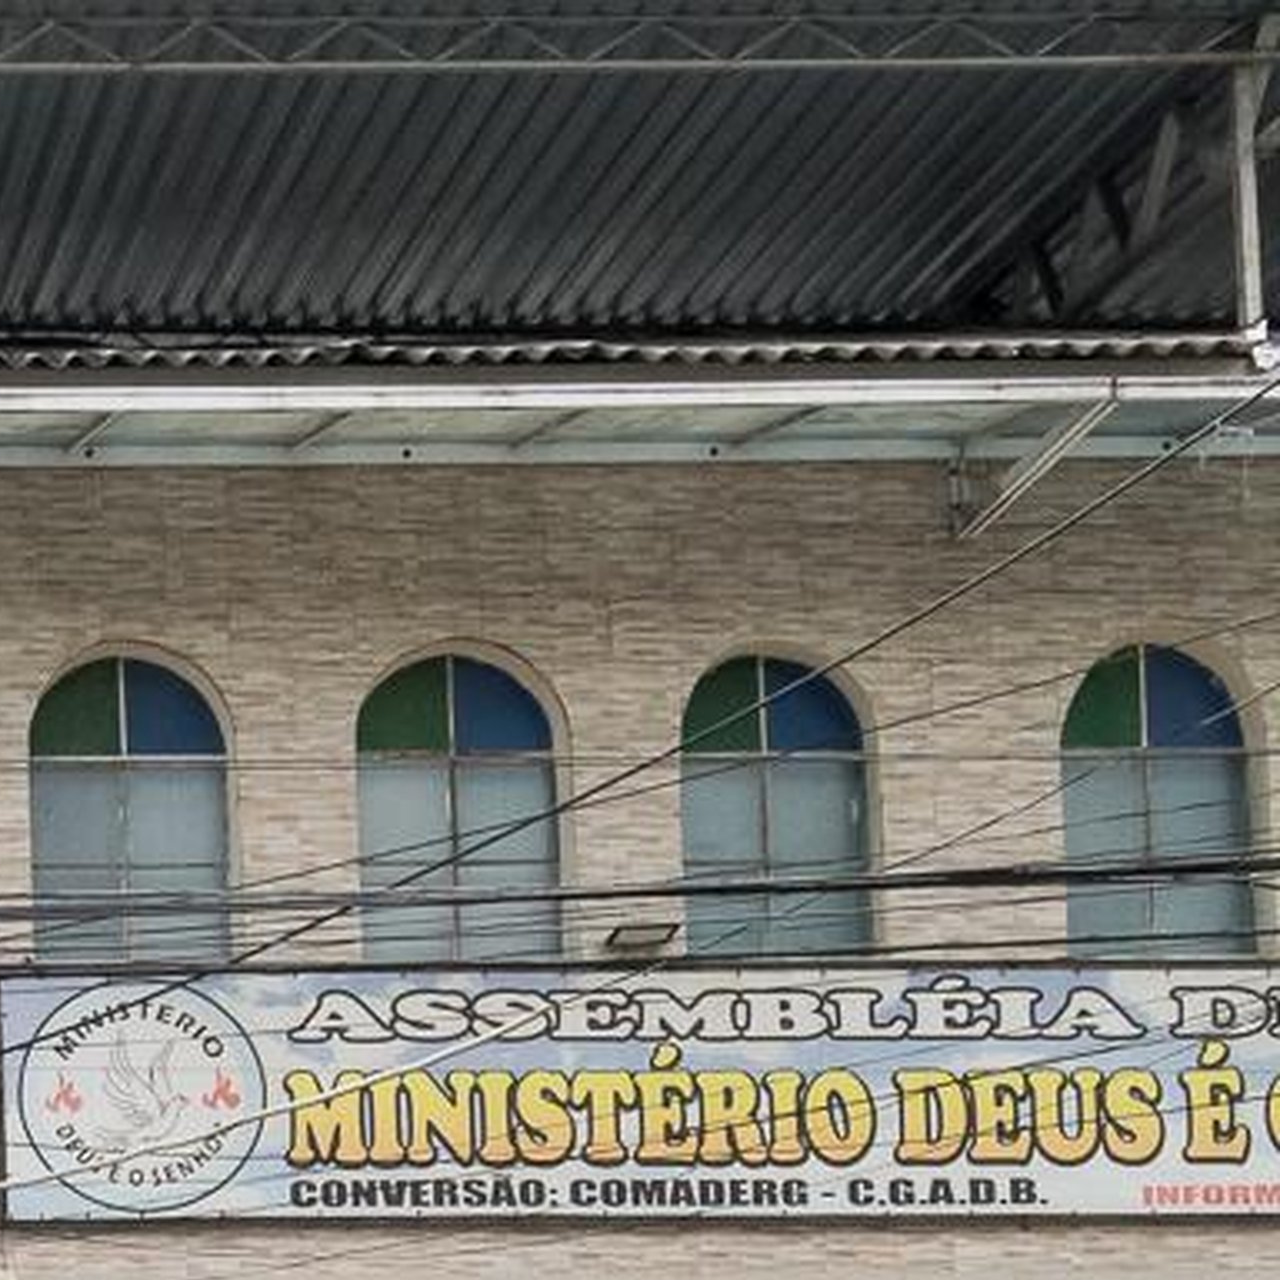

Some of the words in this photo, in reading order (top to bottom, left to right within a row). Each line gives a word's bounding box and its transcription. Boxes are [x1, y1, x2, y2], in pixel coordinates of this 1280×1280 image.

[287, 974, 1148, 1042] ASSEMBLÉIA
[1168, 985, 1280, 1040] D
[281, 1040, 878, 1168] MINISTÉRIO
[893, 1066, 1165, 1167] DEUS
[1178, 1037, 1251, 1164] É
[55, 1122, 103, 1175] DEU
[847, 1178, 1050, 1207] C.G.A.D.B.
